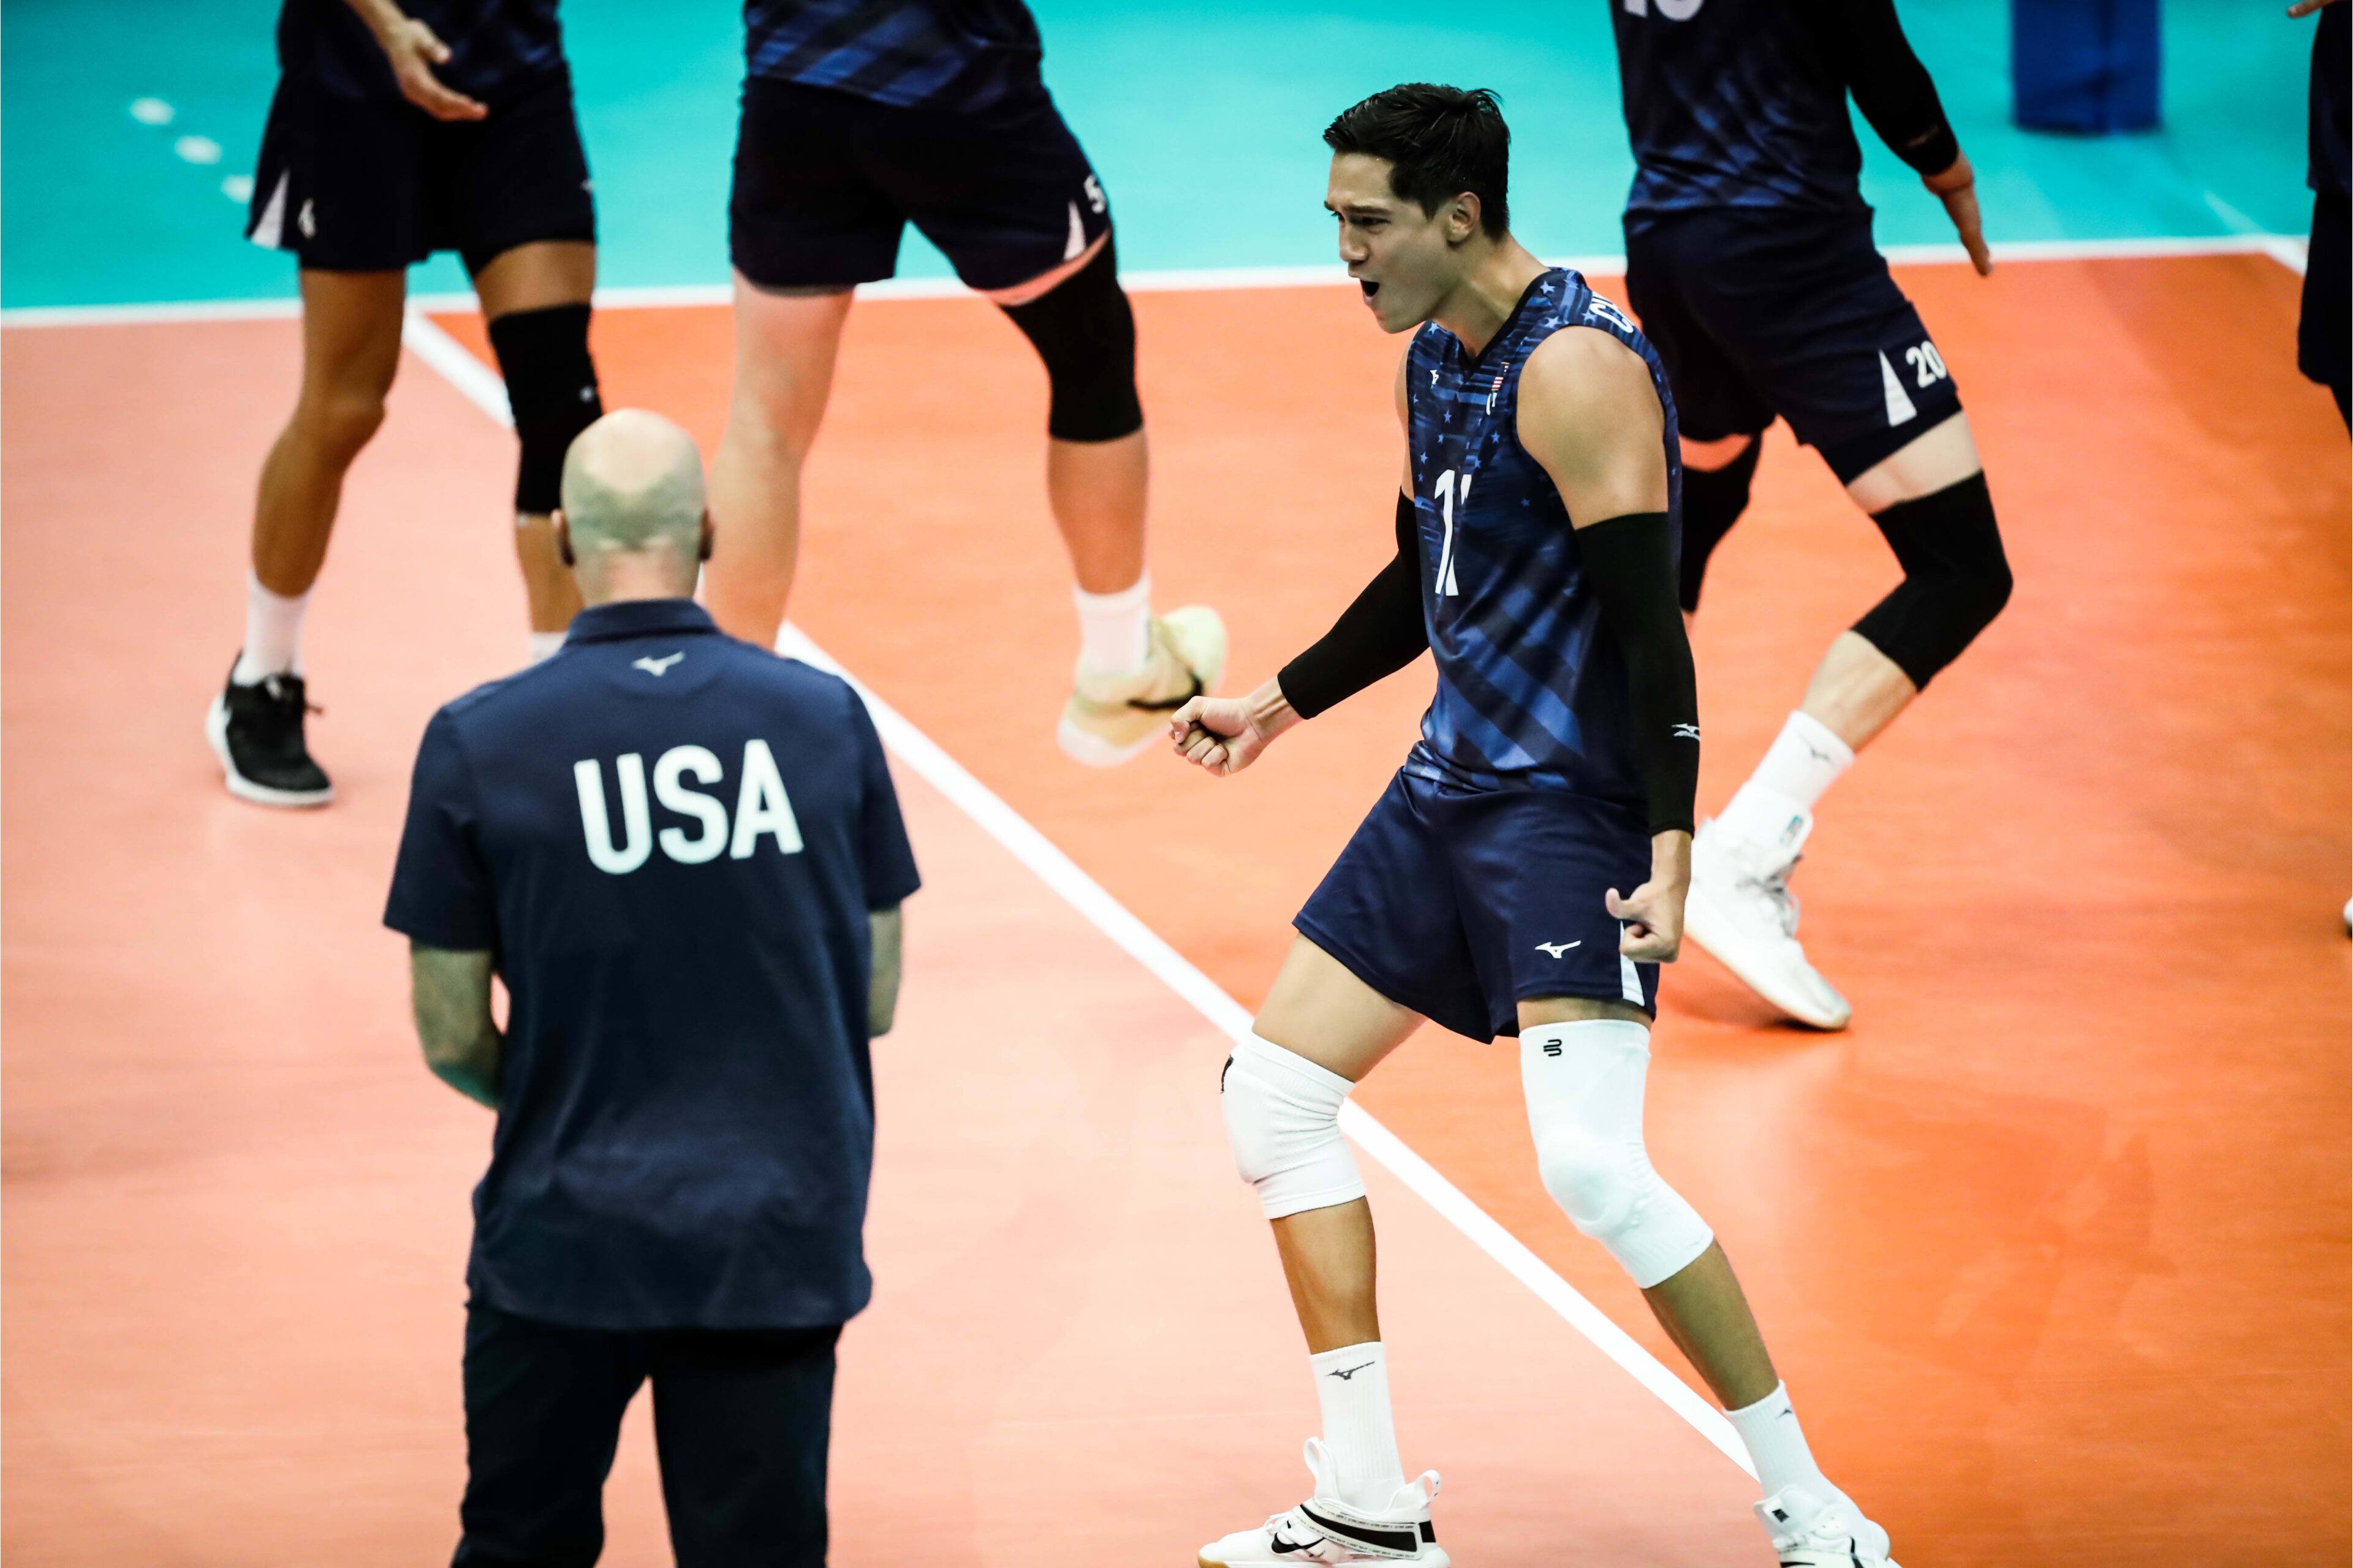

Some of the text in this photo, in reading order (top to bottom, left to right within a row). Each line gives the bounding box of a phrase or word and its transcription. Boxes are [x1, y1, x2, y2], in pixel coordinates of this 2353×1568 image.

[1084, 174, 1106, 214] 5
[1905, 341, 1947, 388] 20
[574, 738, 805, 876] USA
